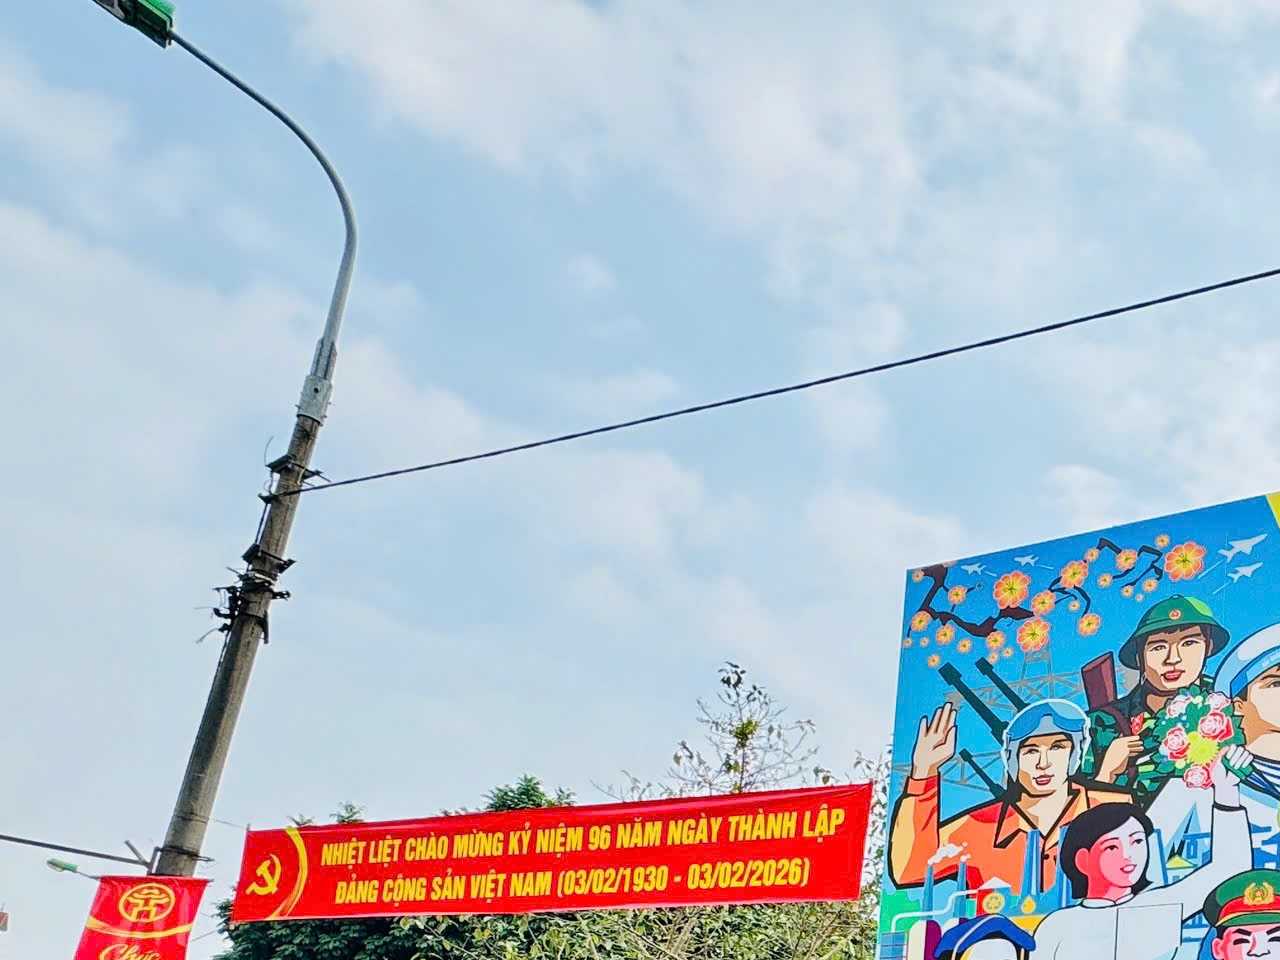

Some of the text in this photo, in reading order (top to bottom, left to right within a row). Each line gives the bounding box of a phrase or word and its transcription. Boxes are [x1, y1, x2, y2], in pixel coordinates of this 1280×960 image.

[321, 803, 846, 869] NHIỆT LIỆT CHÀO MỪNG KỶ NIỆM 96 NĂM NGÀY THÀNH LẬP
[335, 873, 379, 904] ĐẢNG
[382, 873, 427, 907] CỘNG
[430, 868, 466, 900] SẢN
[470, 869, 506, 903] VIỆT
[509, 871, 552, 898] NAM
[557, 864, 669, 898] (03/02/1930
[687, 857, 811, 890] 03/02/2026)
